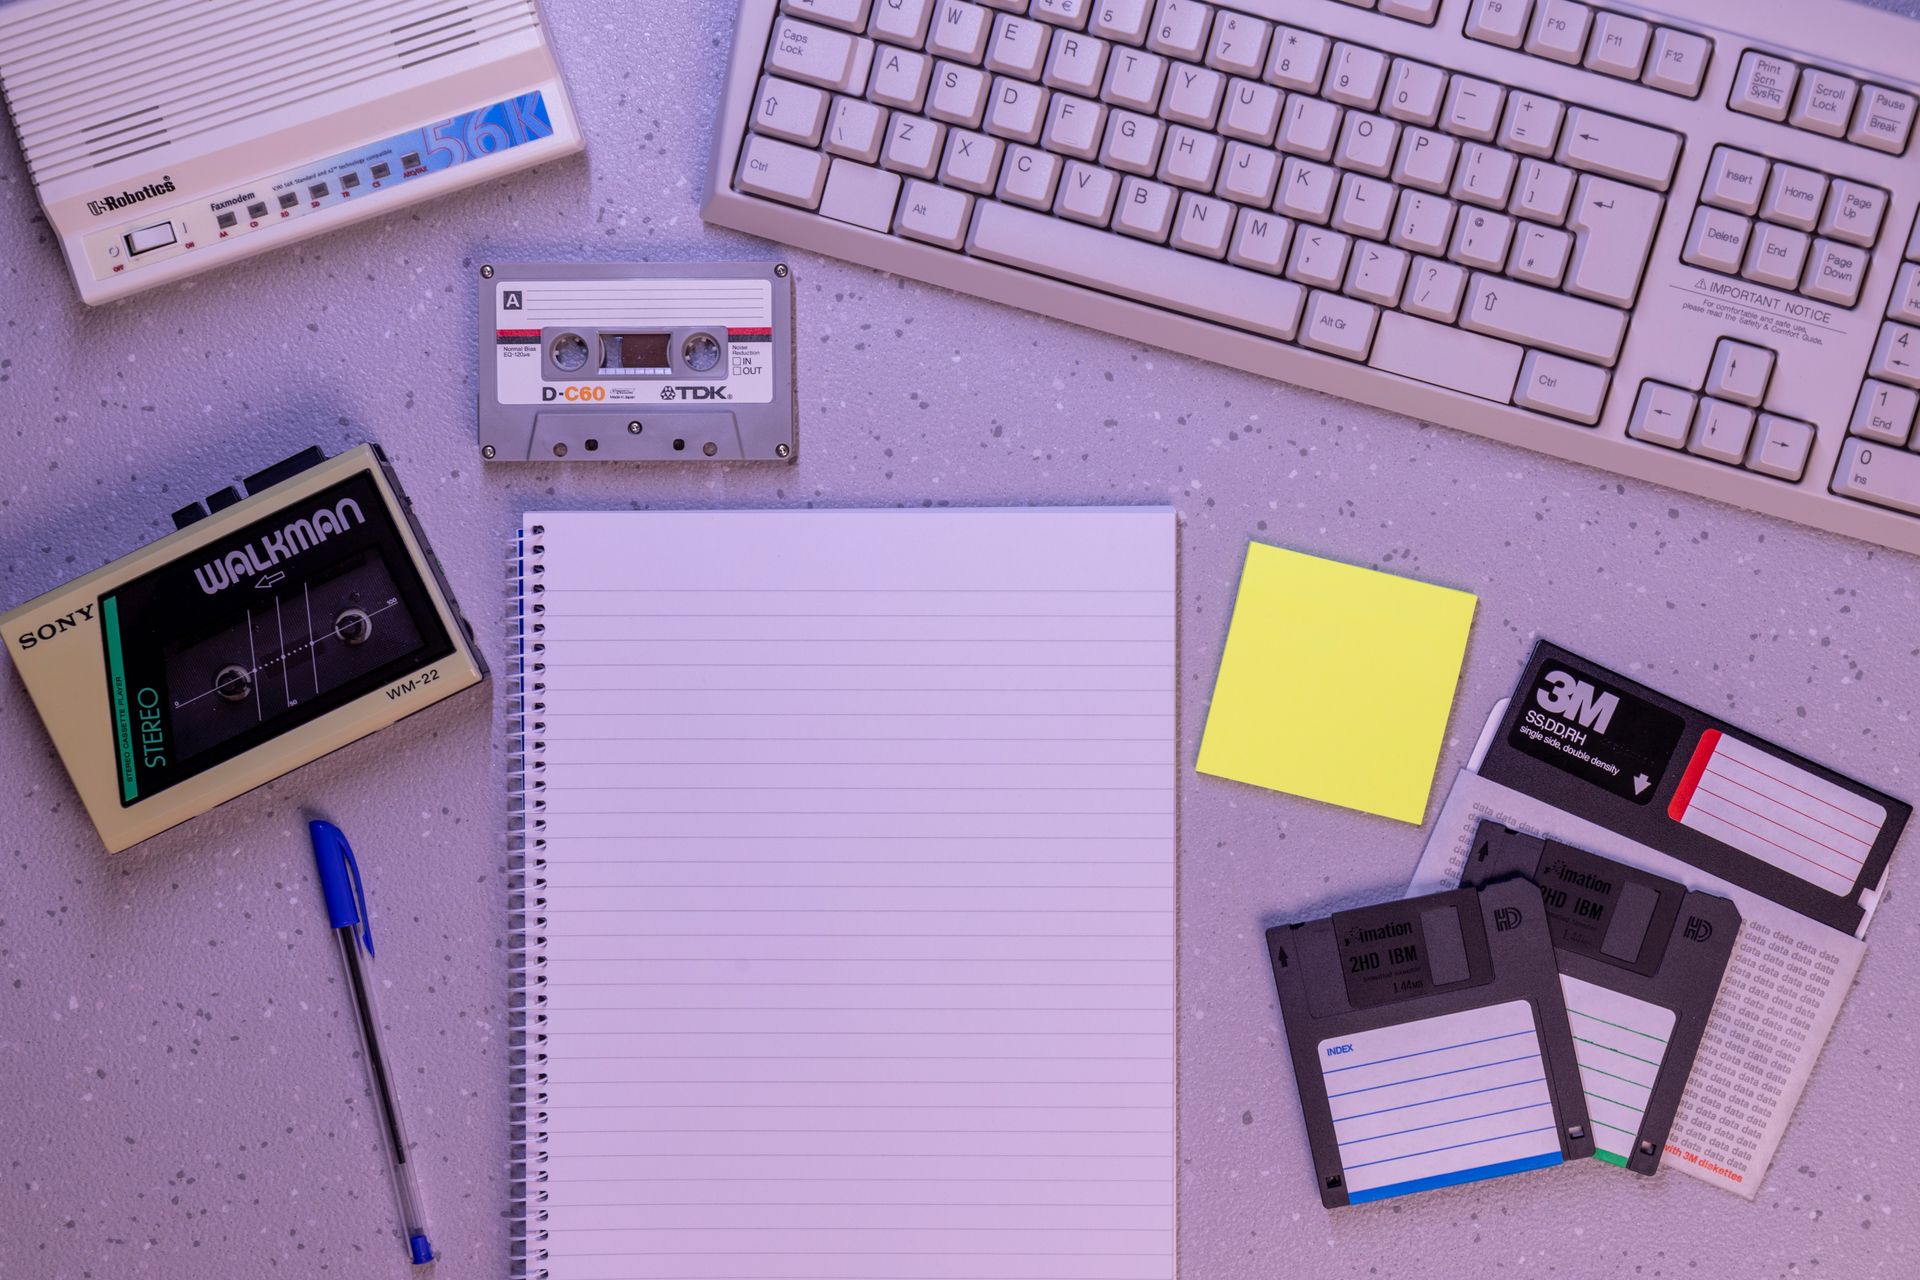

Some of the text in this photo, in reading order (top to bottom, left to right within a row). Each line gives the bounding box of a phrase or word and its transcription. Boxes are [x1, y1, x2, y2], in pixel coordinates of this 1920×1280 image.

[1488, 1, 1502, 13] F9
[947, 8, 963, 25] W
[1103, 10, 1114, 22] 5
[1547, 18, 1566, 31] F10
[782, 28, 808, 44] Caps
[1005, 24, 1019, 41] E
[1162, 26, 1171, 39] 6
[1605, 34, 1623, 47] F11
[779, 42, 804, 57] Lock
[1064, 40, 1079, 58] R
[1222, 42, 1231, 55] 7
[1665, 49, 1684, 63] F12
[885, 55, 900, 73] A
[1126, 56, 1138, 74] T
[1281, 59, 1290, 72] 8
[1757, 60, 1781, 75] Print
[945, 72, 958, 89] S
[1184, 72, 1197, 89] Y
[1340, 74, 1349, 87] 9
[1753, 72, 1776, 87] Scrn
[1003, 88, 1018, 105] D
[1241, 87, 1256, 105] U
[1398, 91, 1408, 103] 0
[1750, 86, 1781, 104] SysRq
[1816, 83, 1846, 100] Scroll
[1812, 97, 1837, 112] Lock
[1877, 94, 1906, 111] Pause
[1061, 103, 1075, 120] F
[421, 91, 553, 168] 56K
[898, 123, 914, 141] Z
[1121, 120, 1136, 138] G
[1358, 121, 1373, 138] O
[1869, 118, 1897, 133] Break
[957, 139, 973, 157] X
[1179, 136, 1195, 155] H
[1415, 136, 1429, 152] P
[294, 172, 317, 184] Standard
[317, 169, 327, 178] and
[338, 157, 365, 170] technology
[366, 149, 393, 163] compatible
[750, 158, 768, 173] Ctrl
[1018, 156, 1033, 173] C
[1239, 152, 1252, 169] J
[1078, 171, 1092, 189] V
[1296, 168, 1311, 187] K
[1726, 169, 1753, 185] Insert
[1134, 187, 1148, 205] B
[1355, 184, 1366, 202] L
[1784, 186, 1815, 202] Home
[210, 192, 255, 212] Faxmodem
[912, 203, 927, 216] Alt
[1846, 194, 1872, 210] Page
[1192, 203, 1208, 222] N
[1843, 207, 1857, 219] Up
[1250, 219, 1269, 237] M
[1707, 227, 1740, 244] Delete
[1766, 243, 1787, 258] End
[1827, 253, 1853, 269] Page
[1823, 265, 1853, 282] Down
[505, 294, 520, 307] A
[1709, 281, 1832, 324] IMPORTANT NOTICE
[1682, 301, 1705, 314] please
[1706, 308, 1723, 319] read
[1725, 312, 1737, 322] the
[1738, 317, 1763, 332] Safety
[1771, 325, 1800, 339] Comfort
[1703, 298, 1714, 308] For
[1716, 302, 1758, 319] comfortable
[1759, 314, 1775, 324] and
[1775, 319, 1792, 329] safe
[1320, 314, 1347, 331] Alt Gr
[1897, 332, 1909, 348] 4
[742, 357, 752, 365] IN
[742, 367, 763, 375] OUT
[1538, 374, 1557, 389] Ctrl
[542, 385, 606, 401] D-C60
[675, 386, 727, 400] TDK
[1880, 391, 1888, 407] 1
[1872, 416, 1892, 431] End
[1860, 450, 1872, 465] 0
[1854, 473, 1867, 485] Ins
[18, 603, 95, 651] SONY
[386, 669, 441, 703] WM-22
[1536, 670, 1620, 734] 3M
[115, 676, 134, 782] STEREO CASSETTE PLAYER
[137, 687, 166, 768] STEREO
[1525, 710, 1588, 746] SS,DD,RH
[1519, 724, 1544, 746] single
[1562, 743, 1590, 764] double
[1589, 754, 1621, 776] density
[1473, 801, 1539, 836] data data data
[1559, 866, 1612, 895] imation
[1573, 897, 1604, 921] IBM
[1359, 921, 1413, 943] imation
[1750, 921, 1840, 965] data data data data
[1349, 945, 1418, 974] 2HD IBM
[1734, 1018, 1801, 1052] data data data
[1327, 1043, 1354, 1056] INDEX
[1705, 1084, 1772, 1118] data data data
[1680, 1138, 1724, 1163] data data
[1682, 1151, 1697, 1164] 3M
[1698, 1158, 1743, 1183] diskettes
